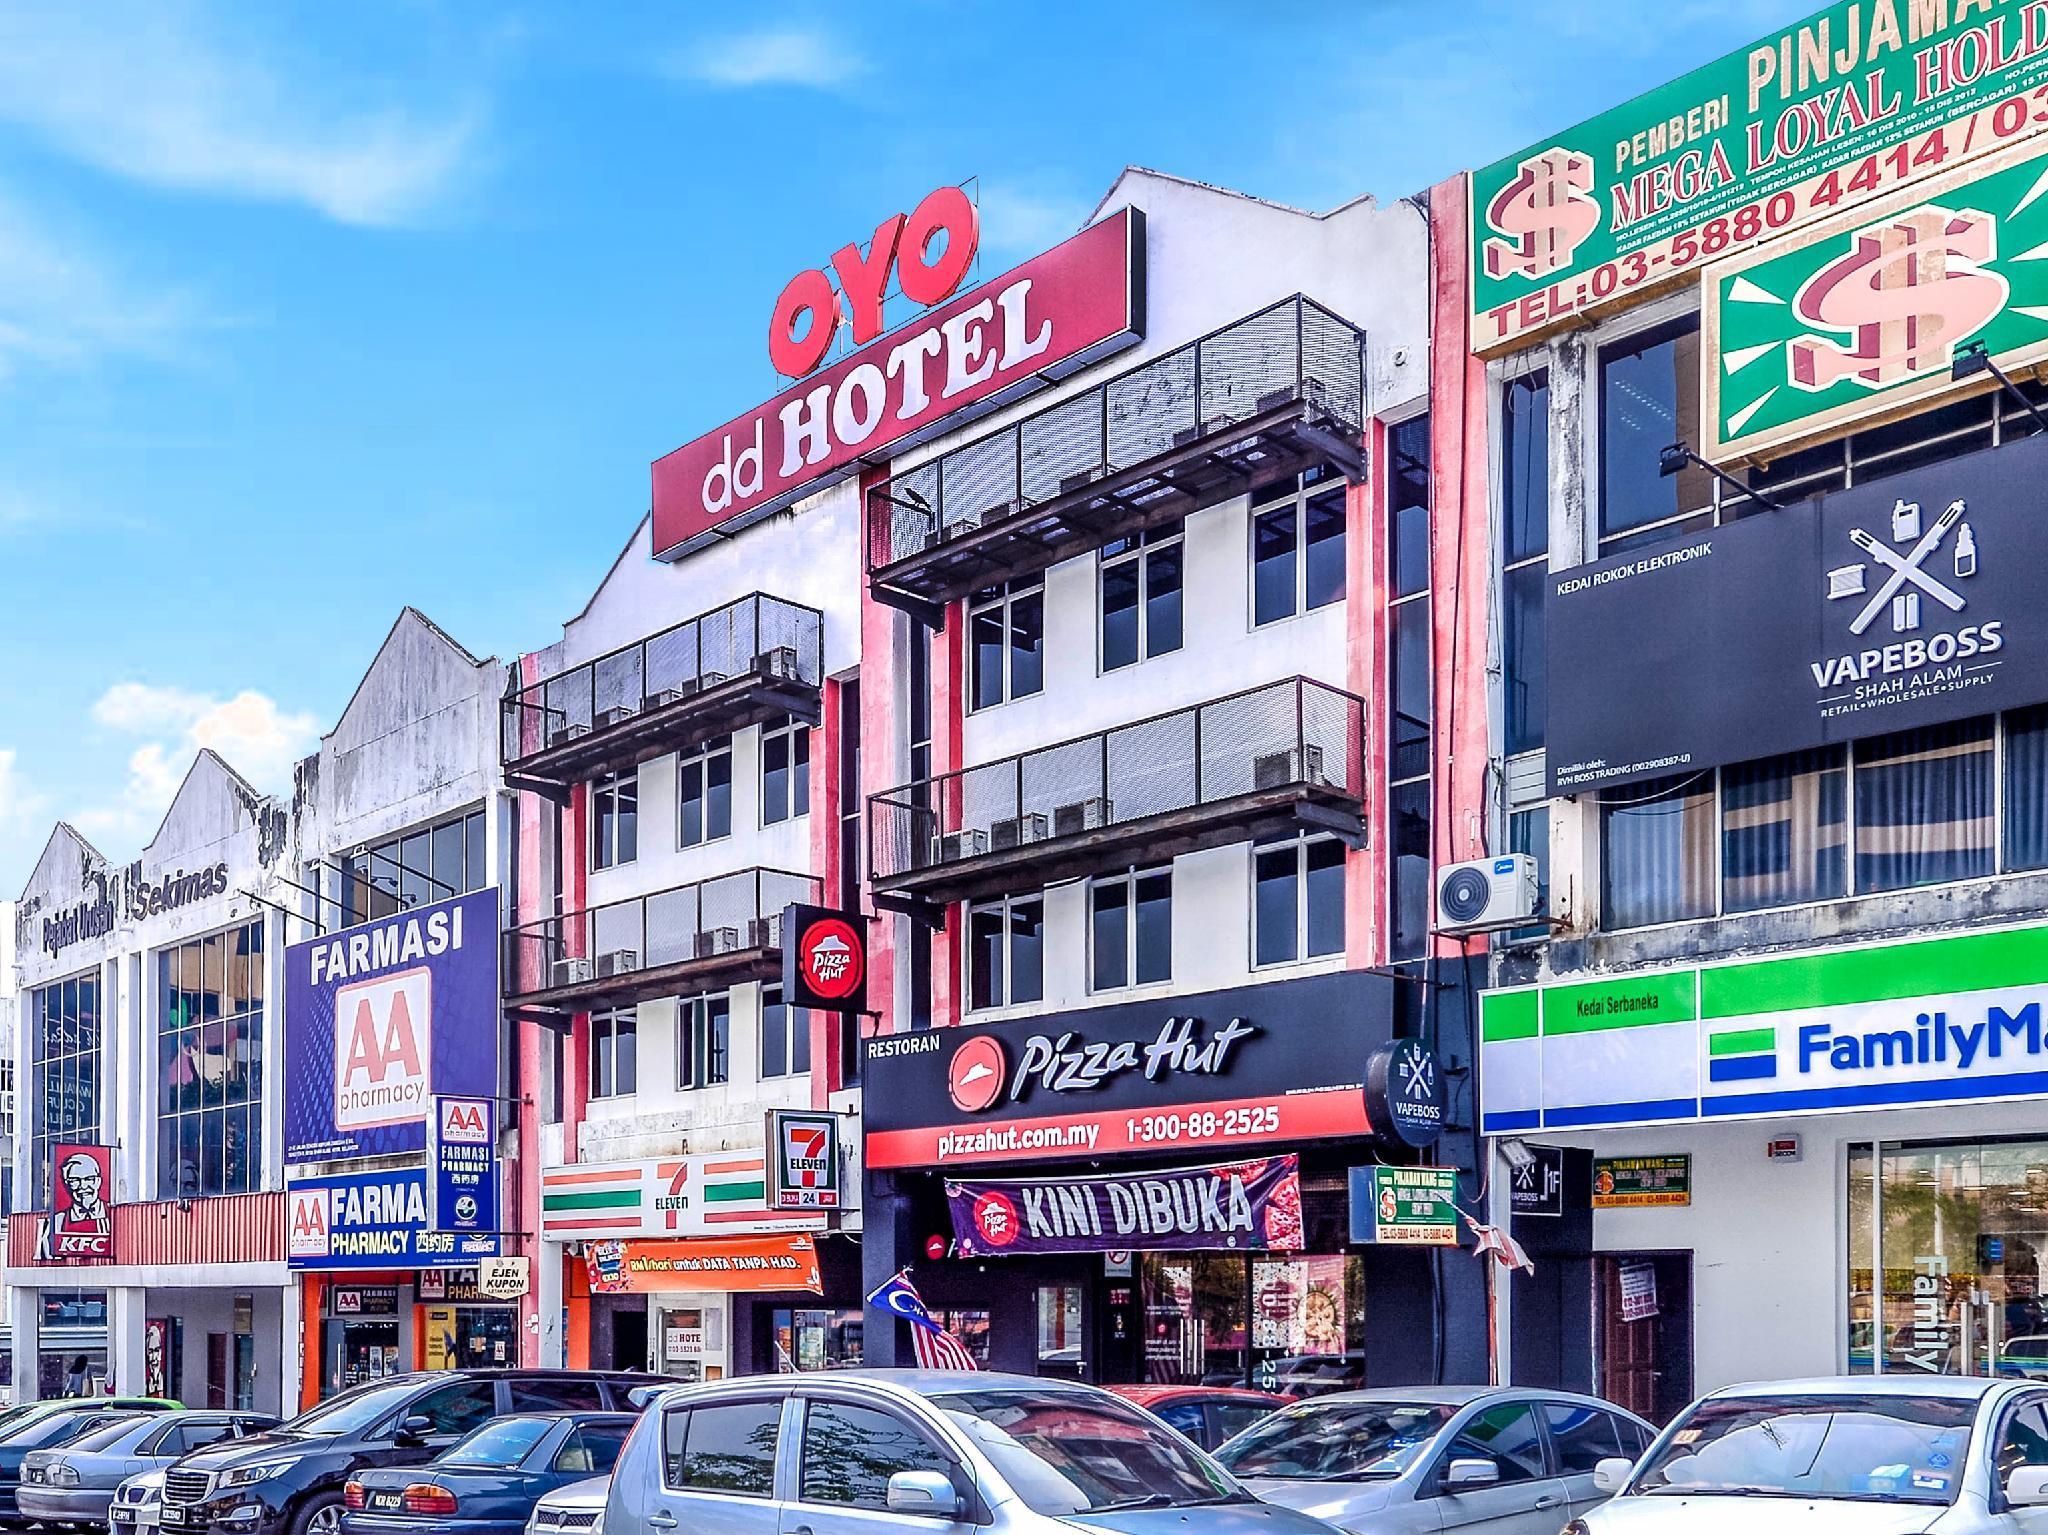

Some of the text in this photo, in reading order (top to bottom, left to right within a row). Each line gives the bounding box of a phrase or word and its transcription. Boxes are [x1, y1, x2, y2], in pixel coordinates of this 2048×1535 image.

[1610, 138, 1736, 233] MEGA
[1745, 68, 1902, 176] LOYAL
[1615, 94, 1729, 173] PEMBERI
[1750, 164, 1787, 186] TEMPOH
[1787, 147, 1830, 170] KESAHAN
[1831, 134, 1865, 153] LESEN:
[1878, 121, 1894, 133] DIS
[1936, 97, 1953, 110] DIS
[1761, 165, 1818, 194] BERCAGAR)
[1821, 152, 1850, 170] KADAR
[1904, 113, 1944, 136] SETAHUN
[1946, 82, 2018, 119] (BERCAGAR)
[1810, 128, 1949, 208] 4414
[1963, 113, 1979, 154] /
[768, 186, 979, 381] OYO
[701, 278, 1053, 514] dd HOTEL
[1557, 541, 1713, 596] KEDAI ROKOK ELEKTRONIK
[1810, 620, 2003, 688] VAPEBOSS
[1854, 664, 1963, 700] SHAH ALAM
[1574, 771, 1595, 784] BOSS
[1596, 764, 1631, 779] TRADING
[131, 862, 228, 921] Sekimas
[43, 908, 78, 959] Pejabat
[311, 905, 463, 986] FARMASI
[812, 951, 851, 974] Pizza
[818, 965, 847, 983] Hut
[1577, 992, 1658, 1017] Kedai Serbaneka
[343, 990, 422, 1088] AA
[867, 1034, 940, 1059] RESTORAN
[1799, 1002, 2048, 1073] FamilyM
[1009, 1016, 1255, 1102] Pizza Hut
[340, 1081, 424, 1114] pharmacy
[1396, 1101, 1441, 1119] VAPEBOSS
[446, 1105, 484, 1131] AA
[937, 1105, 1280, 1160] pizzahut.com.my 1-300-88-2525
[441, 1145, 489, 1161] FARMASI
[441, 1160, 490, 1172] PHARMACY
[790, 1158, 826, 1170] ELEVEN
[802, 1192, 816, 1204] 24
[1548, 1170, 1560, 1193] 1F
[293, 1198, 325, 1237] AA
[331, 1182, 427, 1226] FARMA
[656, 1196, 688, 1210] ELEVEN
[1022, 1174, 1254, 1238] KINI DIBUKA
[984, 1213, 1008, 1230] Pizza
[989, 1222, 1008, 1237] Hut
[58, 1236, 108, 1253] KFC
[331, 1230, 409, 1256] PHARMACY
[491, 1268, 519, 1277] EJEN
[672, 1258, 702, 1272] untuk
[702, 1257, 731, 1272] DATA
[732, 1256, 769, 1271] TANPA
[770, 1255, 801, 1270] HAD.
[486, 1279, 524, 1288] KUPON
[1904, 1256, 1949, 1373] Family
